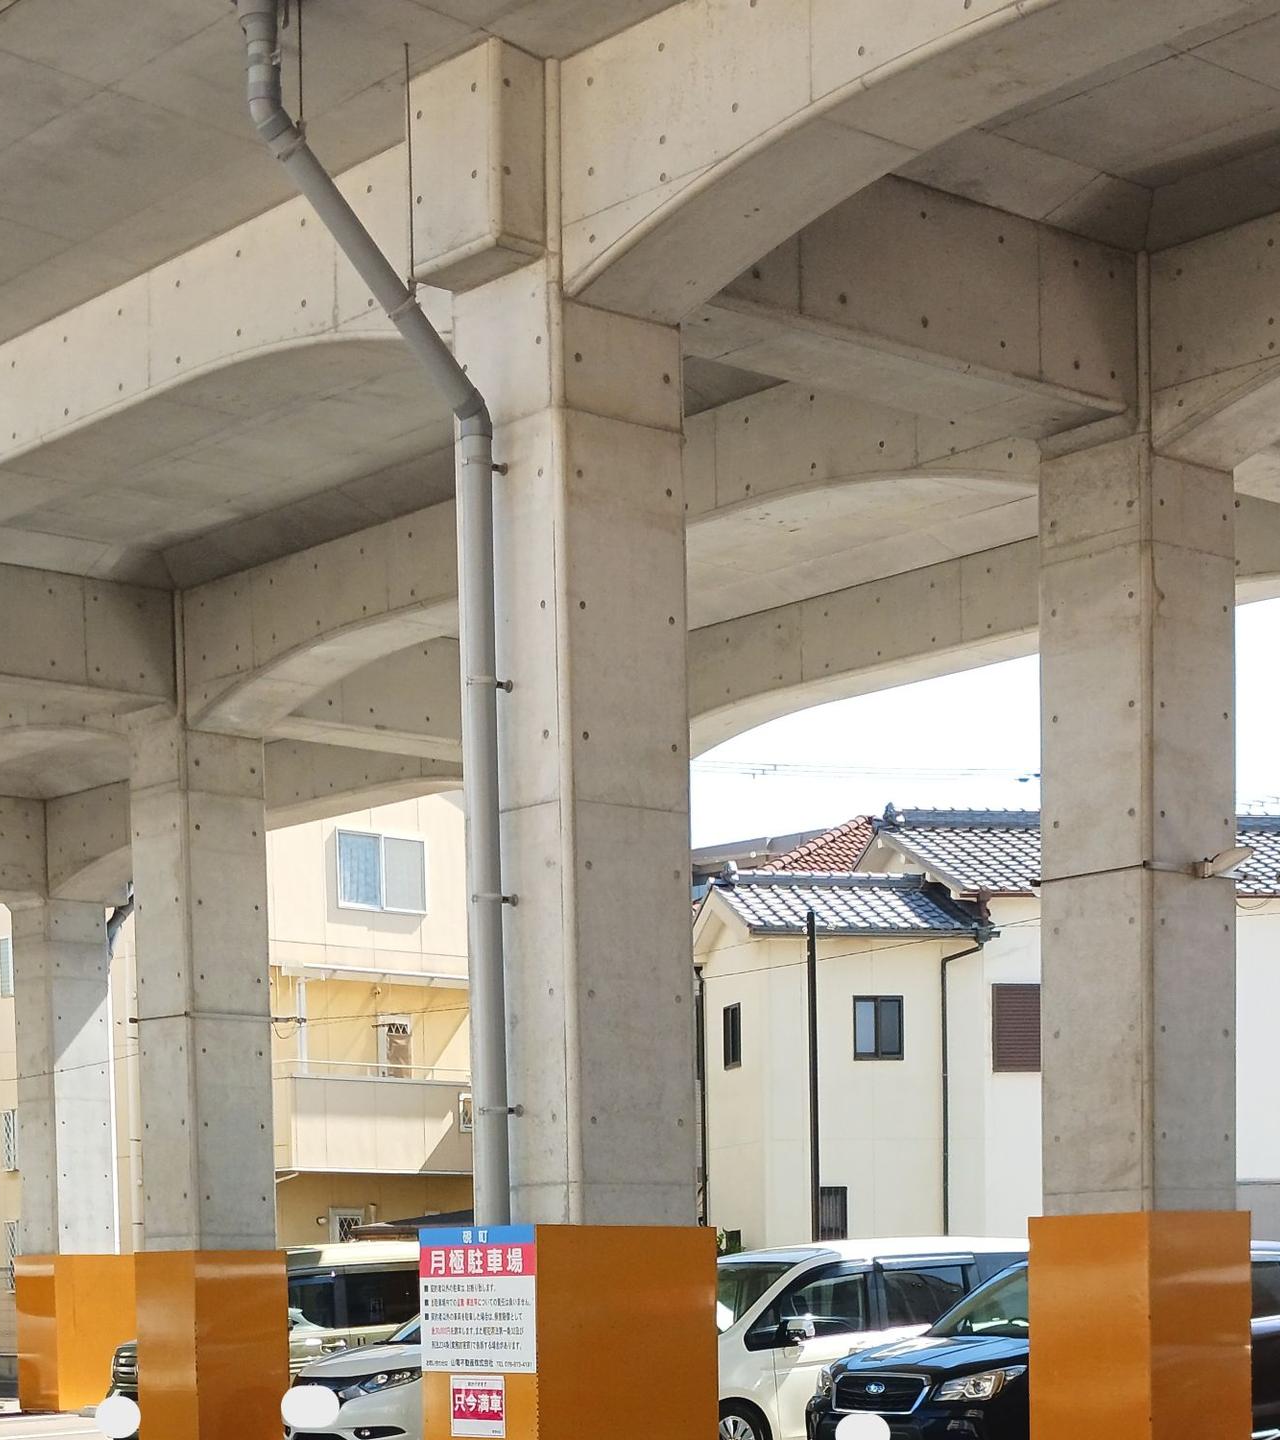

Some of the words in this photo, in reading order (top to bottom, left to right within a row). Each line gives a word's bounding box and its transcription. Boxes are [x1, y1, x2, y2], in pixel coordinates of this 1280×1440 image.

[429, 1247, 523, 1275] 月極駐車場
[454, 1392, 502, 1413] 只今満車
